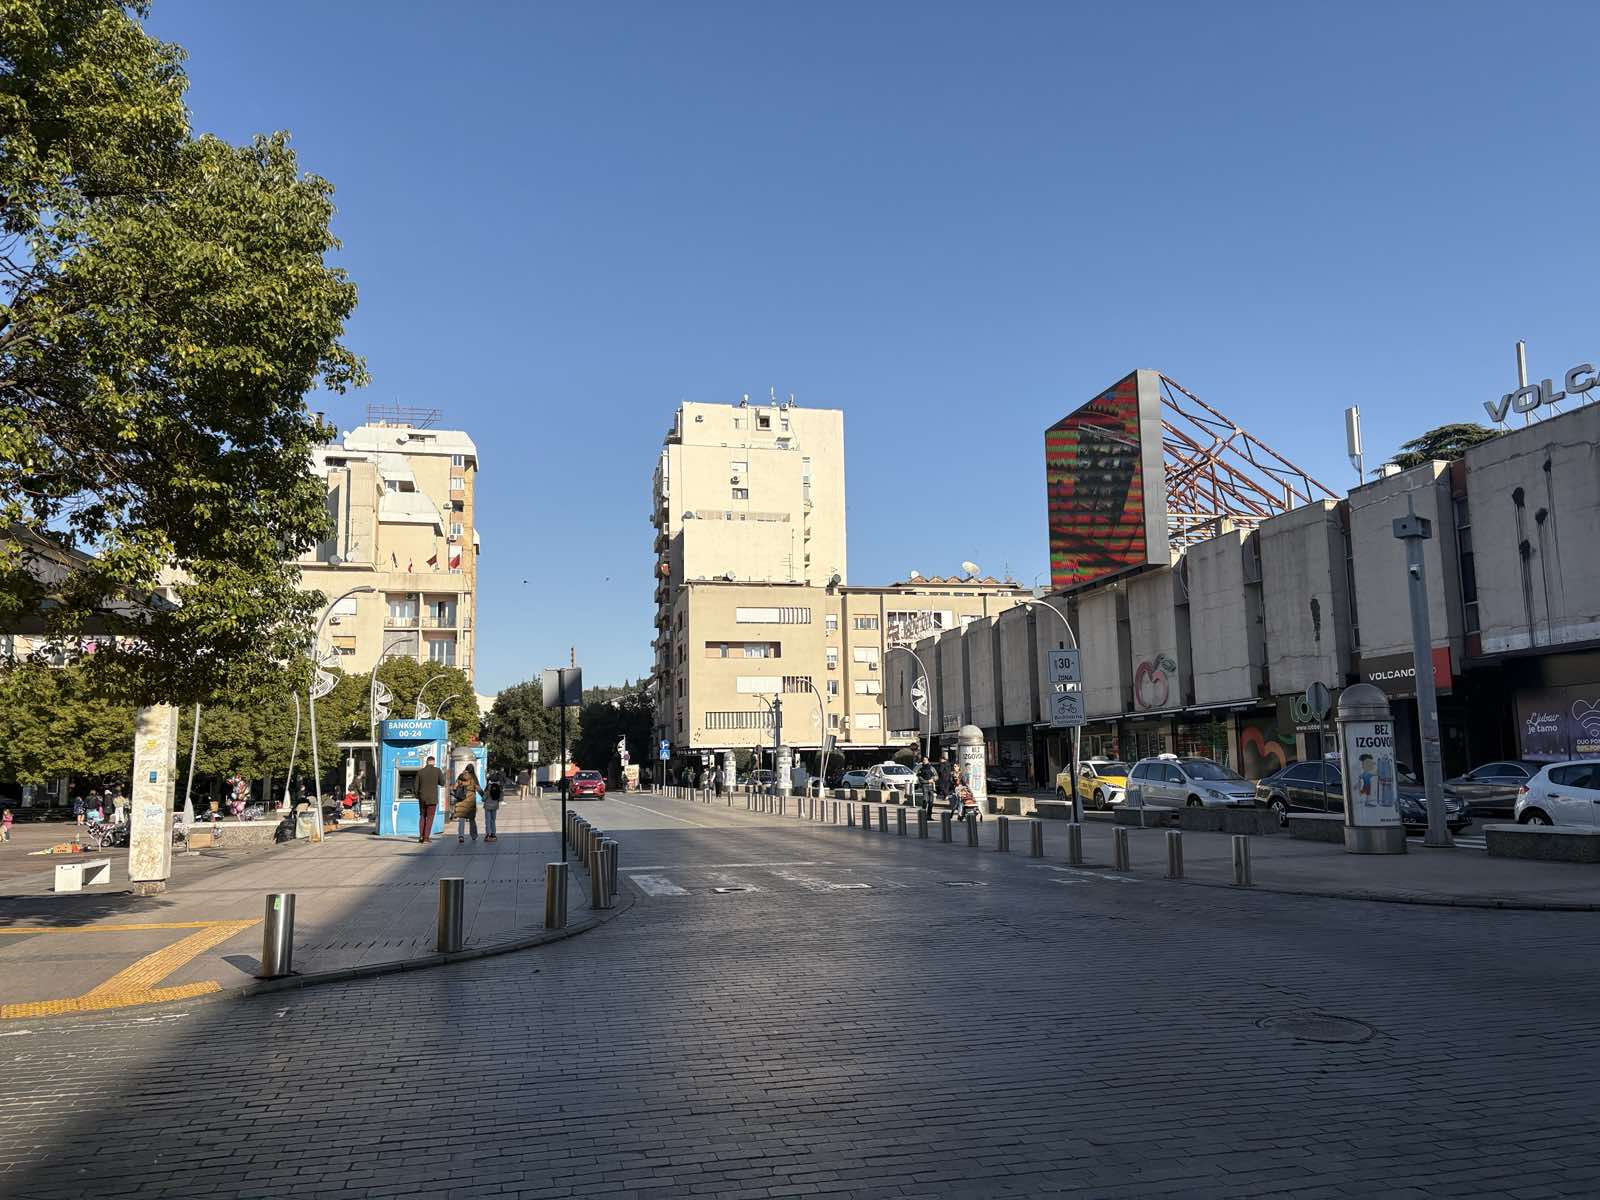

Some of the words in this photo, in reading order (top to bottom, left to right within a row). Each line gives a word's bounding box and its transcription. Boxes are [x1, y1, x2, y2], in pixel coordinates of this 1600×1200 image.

[1483, 363, 1600, 423] VOLC
[1058, 658, 1070, 669] 30
[1368, 668, 1416, 681] VOLCANO
[388, 721, 433, 729] BANKOMAT
[1374, 724, 1389, 735] BEZ
[1528, 725, 1536, 735] je
